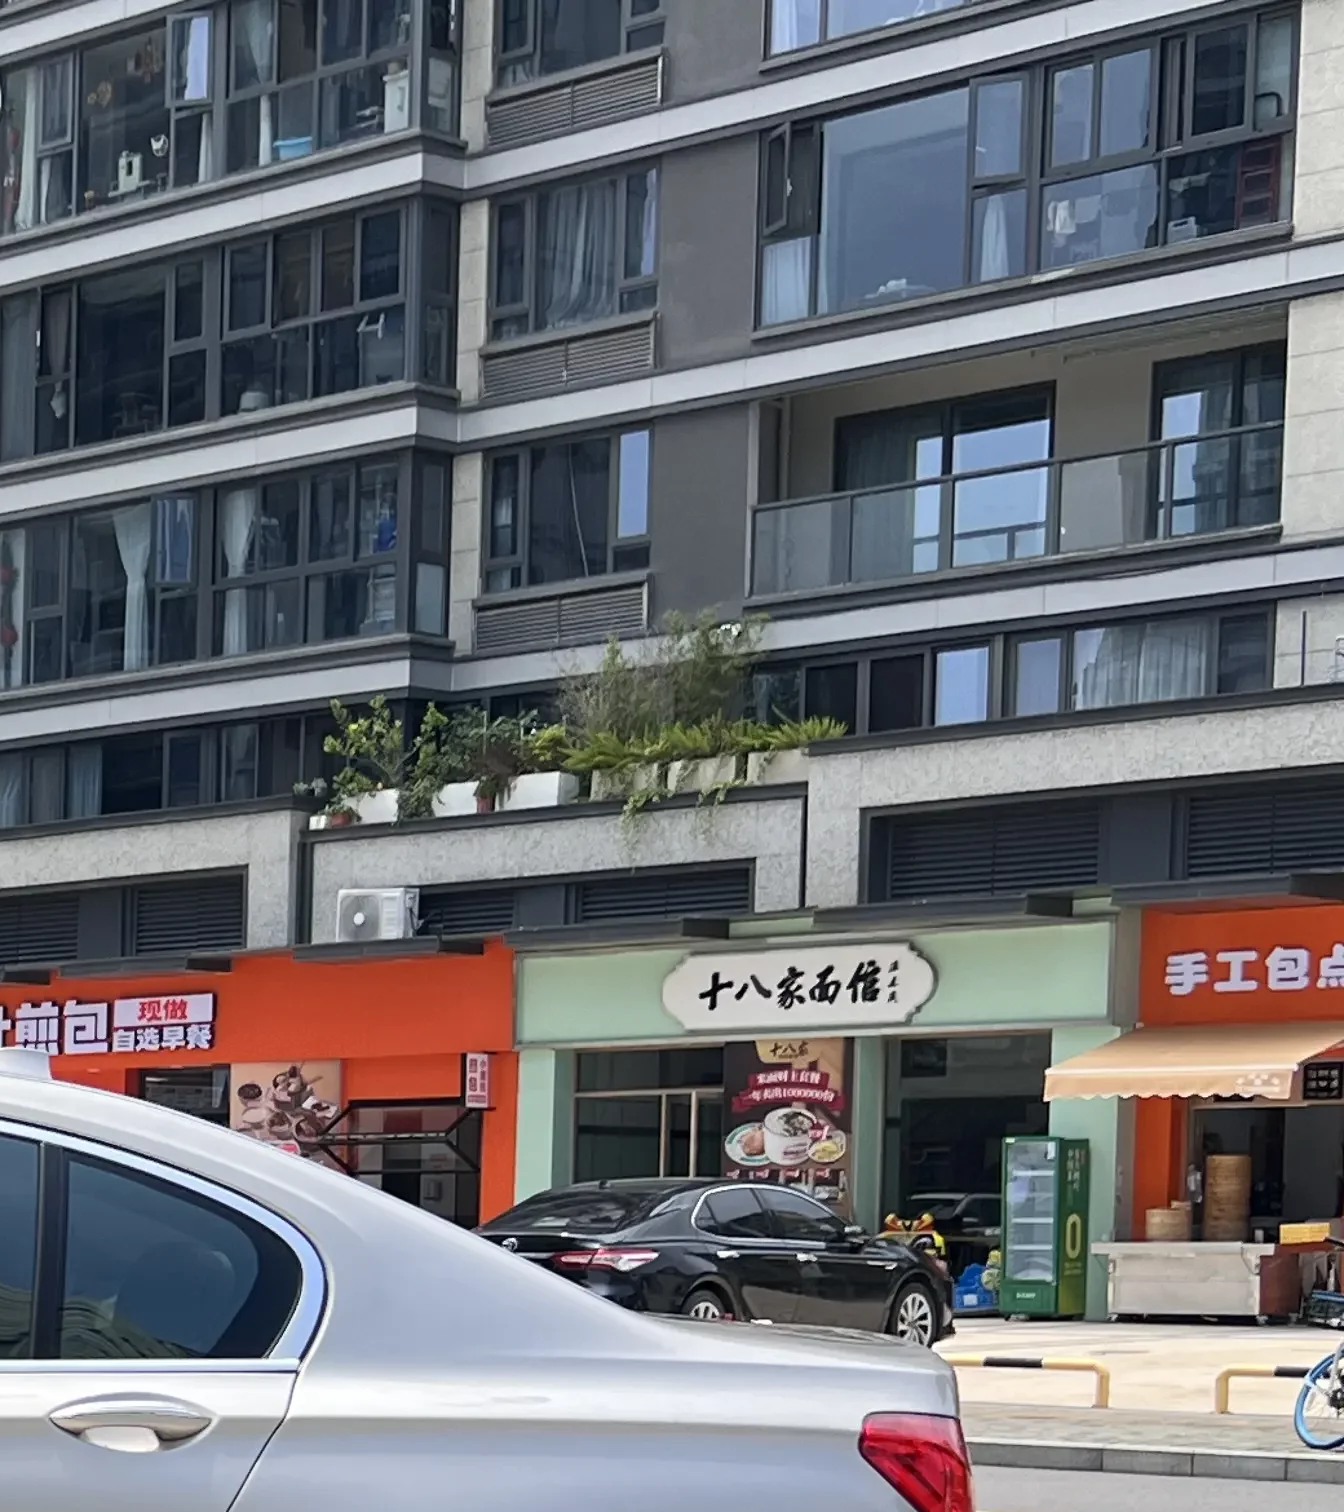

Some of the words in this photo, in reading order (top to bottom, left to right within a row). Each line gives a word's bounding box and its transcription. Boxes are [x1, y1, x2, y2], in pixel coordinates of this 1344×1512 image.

[1164, 943, 1344, 996] 手工包点
[137, 998, 188, 1021] 现做
[112, 1023, 212, 1053] 自选早餐
